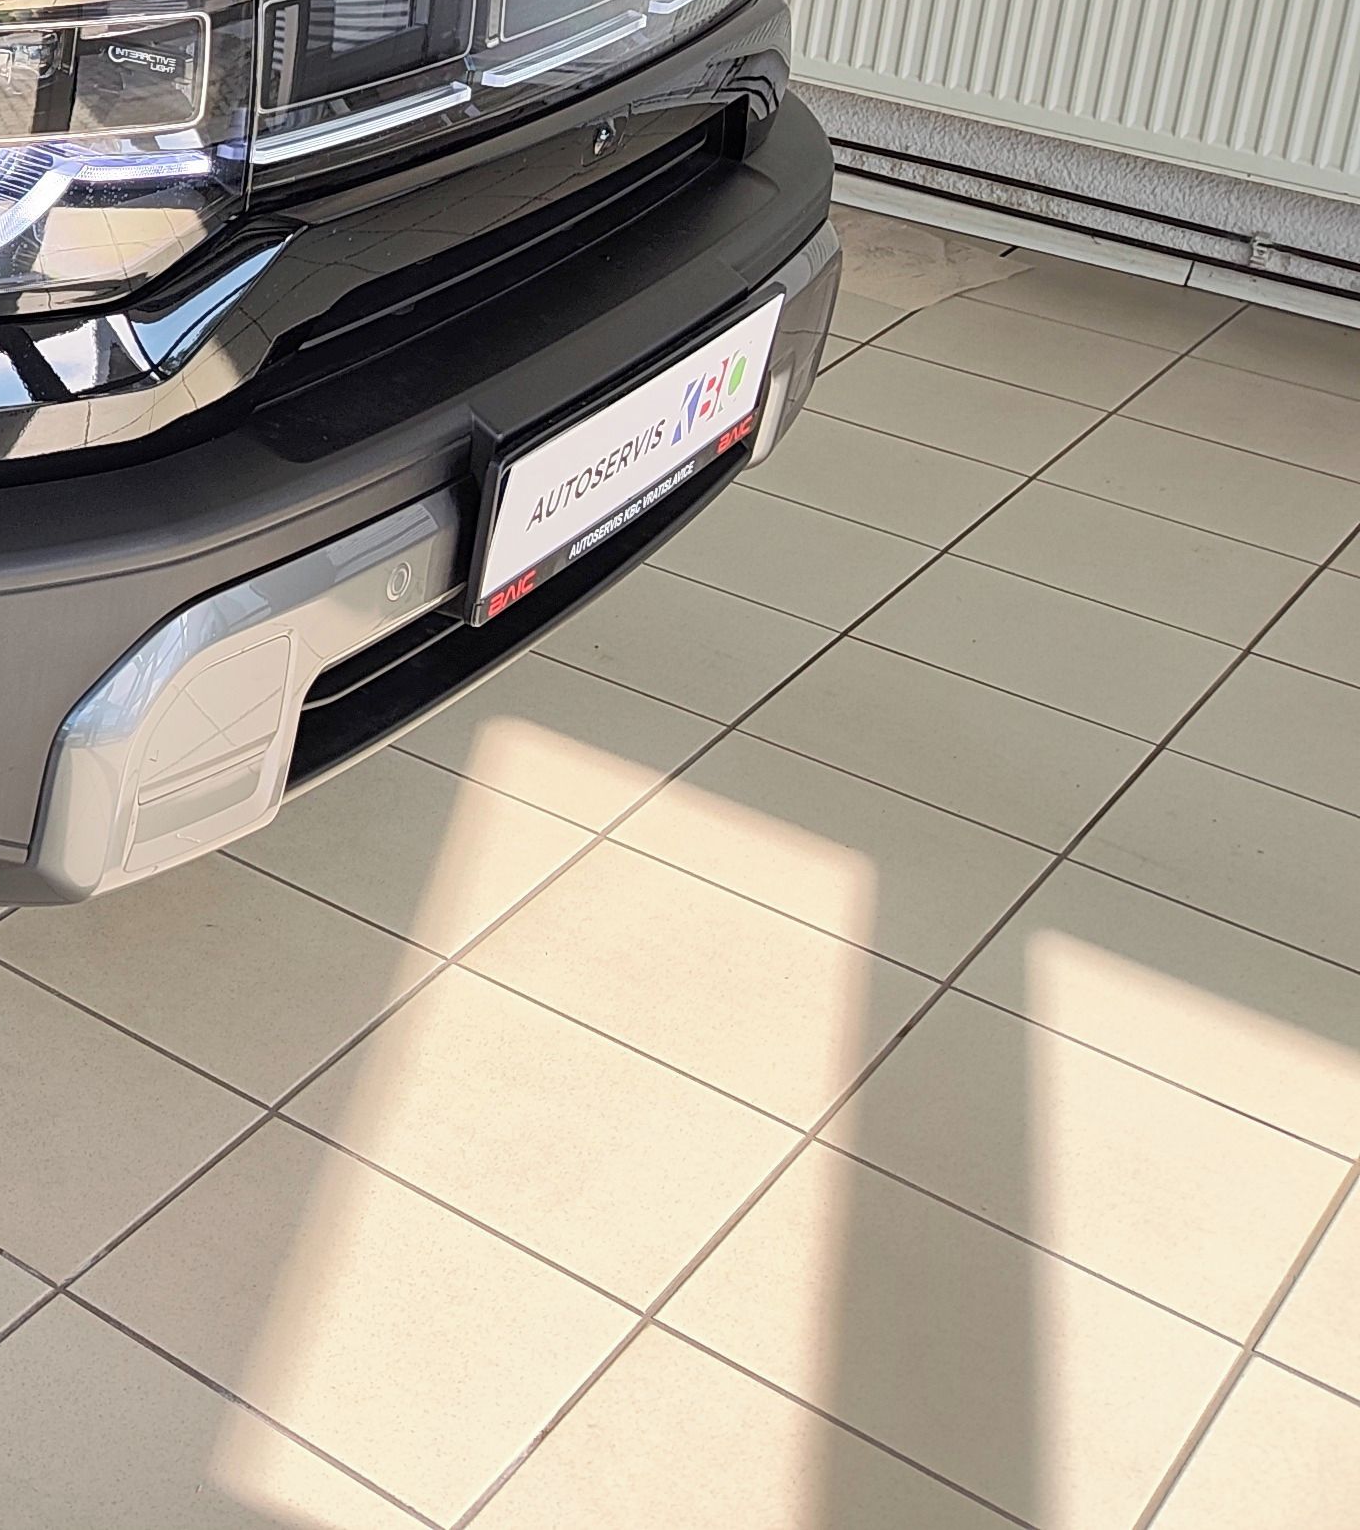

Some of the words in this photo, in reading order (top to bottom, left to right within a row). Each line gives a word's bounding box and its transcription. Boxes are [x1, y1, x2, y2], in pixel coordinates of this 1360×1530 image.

[115, 47, 176, 67] INTERACTIVE
[150, 62, 176, 74] LIGHT
[716, 414, 754, 455] BAIC
[525, 418, 667, 532] AUTOSERVIS
[568, 512, 624, 560] AUTOSERVIS
[624, 499, 642, 522] KBC
[642, 460, 696, 508] VRATISLAVICE
[487, 569, 537, 617] BAIC
